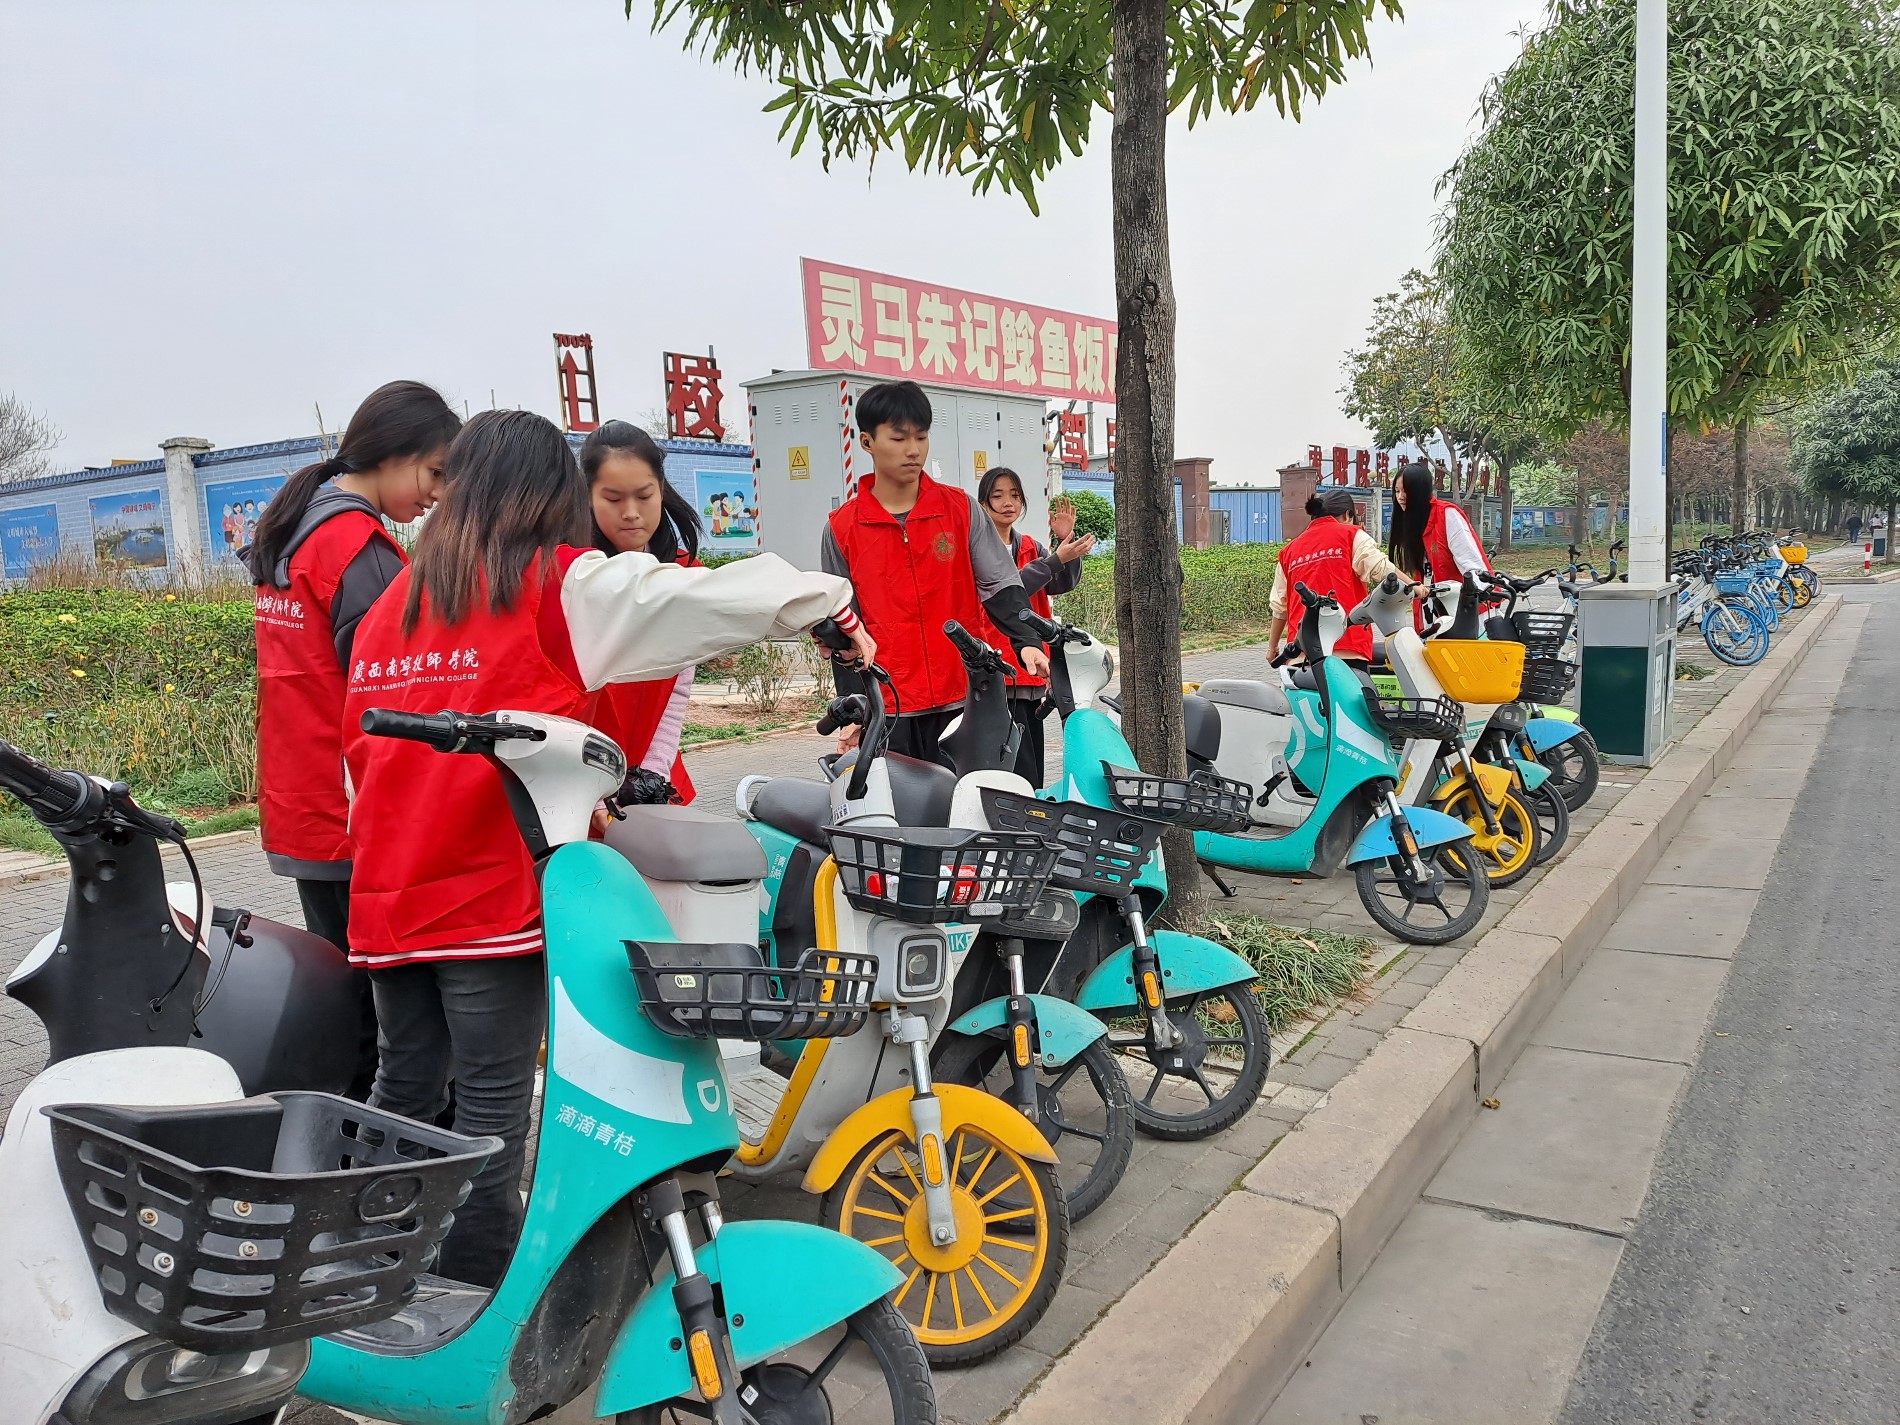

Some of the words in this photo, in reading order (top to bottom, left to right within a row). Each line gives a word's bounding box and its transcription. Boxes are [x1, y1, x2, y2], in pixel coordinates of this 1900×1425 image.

[818, 270, 1118, 396] 灵马朱记鲶鱼饭
[666, 353, 726, 438] 校
[1059, 409, 1089, 472] 驾
[447, 673, 478, 682] COLLEGE
[555, 1103, 636, 1157] 滴滴青桔
